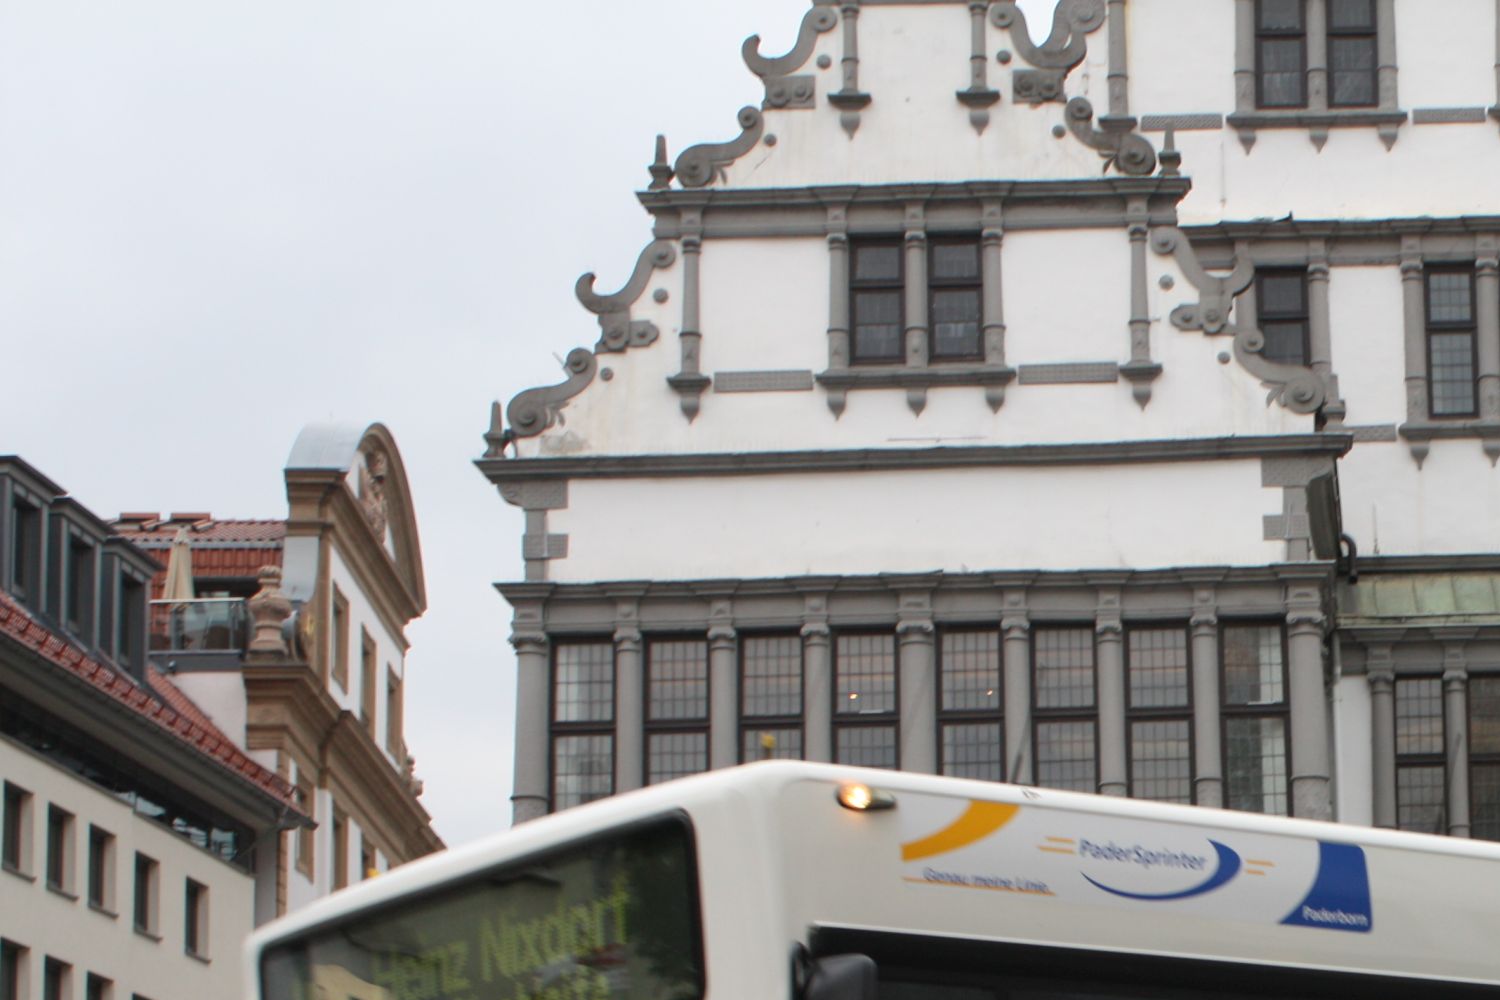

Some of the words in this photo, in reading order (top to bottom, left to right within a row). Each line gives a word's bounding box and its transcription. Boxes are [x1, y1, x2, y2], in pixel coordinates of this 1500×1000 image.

[1078, 837, 1207, 871] PaderSprinter
[969, 874, 1013, 892] meine
[478, 867, 631, 983] Nixdorf
[1301, 904, 1369, 927] Paderborn
